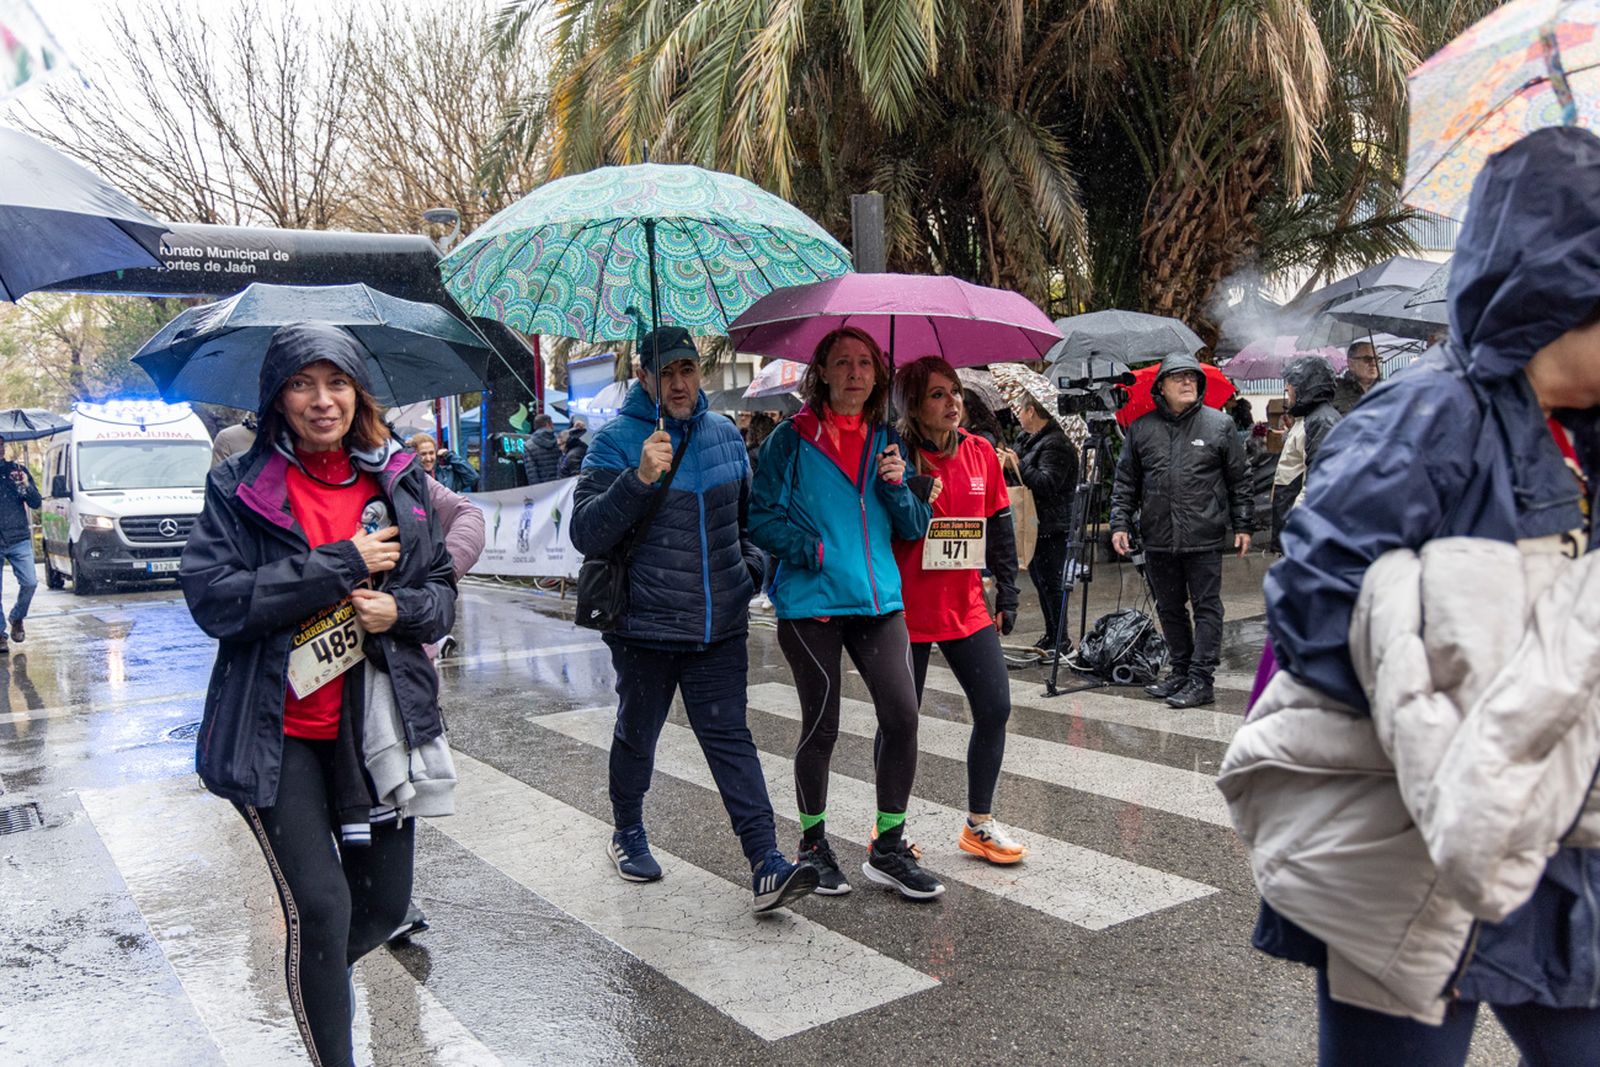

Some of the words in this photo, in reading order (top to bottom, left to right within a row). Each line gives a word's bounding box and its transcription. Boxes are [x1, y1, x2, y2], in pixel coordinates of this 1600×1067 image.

[159, 246, 203, 257] ronato
[207, 247, 269, 260] Municipal
[273, 250, 289, 261] de
[204, 260, 221, 271] de
[224, 260, 256, 273] Jaén
[940, 521, 951, 529] San
[959, 530, 982, 538] POPULAR
[943, 541, 968, 559] 471
[294, 617, 334, 646] CARRERA
[310, 620, 358, 665] 485
[290, 923, 298, 964] LIFESTYLE
[291, 965, 307, 1022] METROPOLITAN
